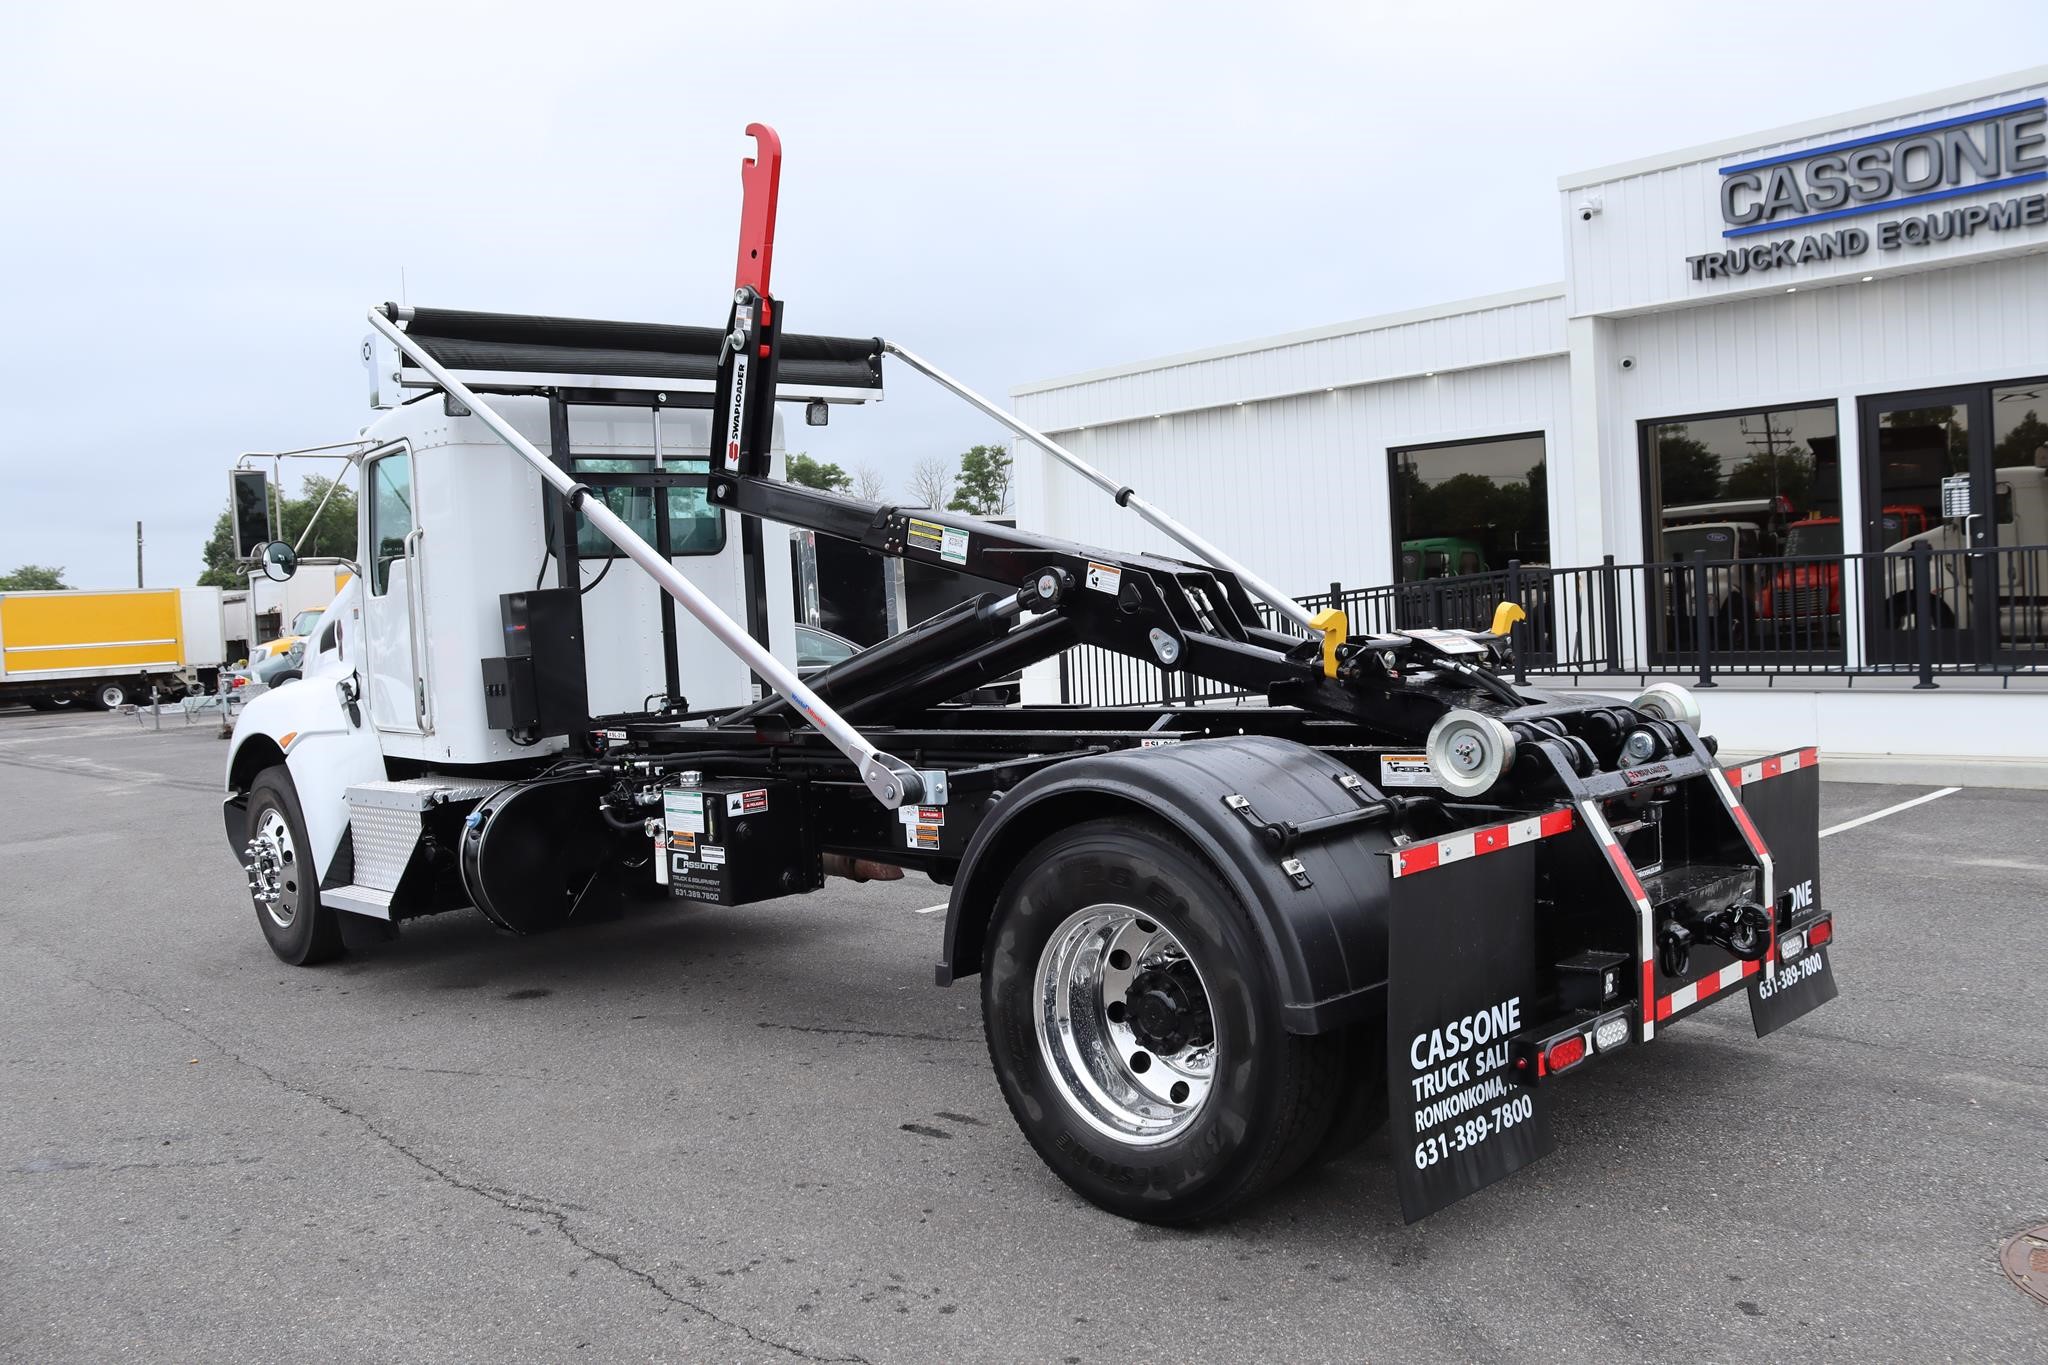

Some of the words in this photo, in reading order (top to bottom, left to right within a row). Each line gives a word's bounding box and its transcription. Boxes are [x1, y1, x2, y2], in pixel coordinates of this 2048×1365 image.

[1720, 111, 2047, 225] CASSONE
[1686, 238, 1796, 280] TRUCK
[1797, 227, 1869, 263] AND
[1878, 194, 2048, 250] EQUIPME
[732, 363, 745, 440] SWAPLOADER
[672, 852, 719, 874] CASSONE
[1760, 952, 1822, 999] 631-389-7800
[1410, 997, 1521, 1071] CASSONE
[1412, 1057, 1470, 1102] TRUCK
[1415, 1075, 1507, 1132] RONKONKOMA,
[1415, 1094, 1533, 1170] 631-389-7800
